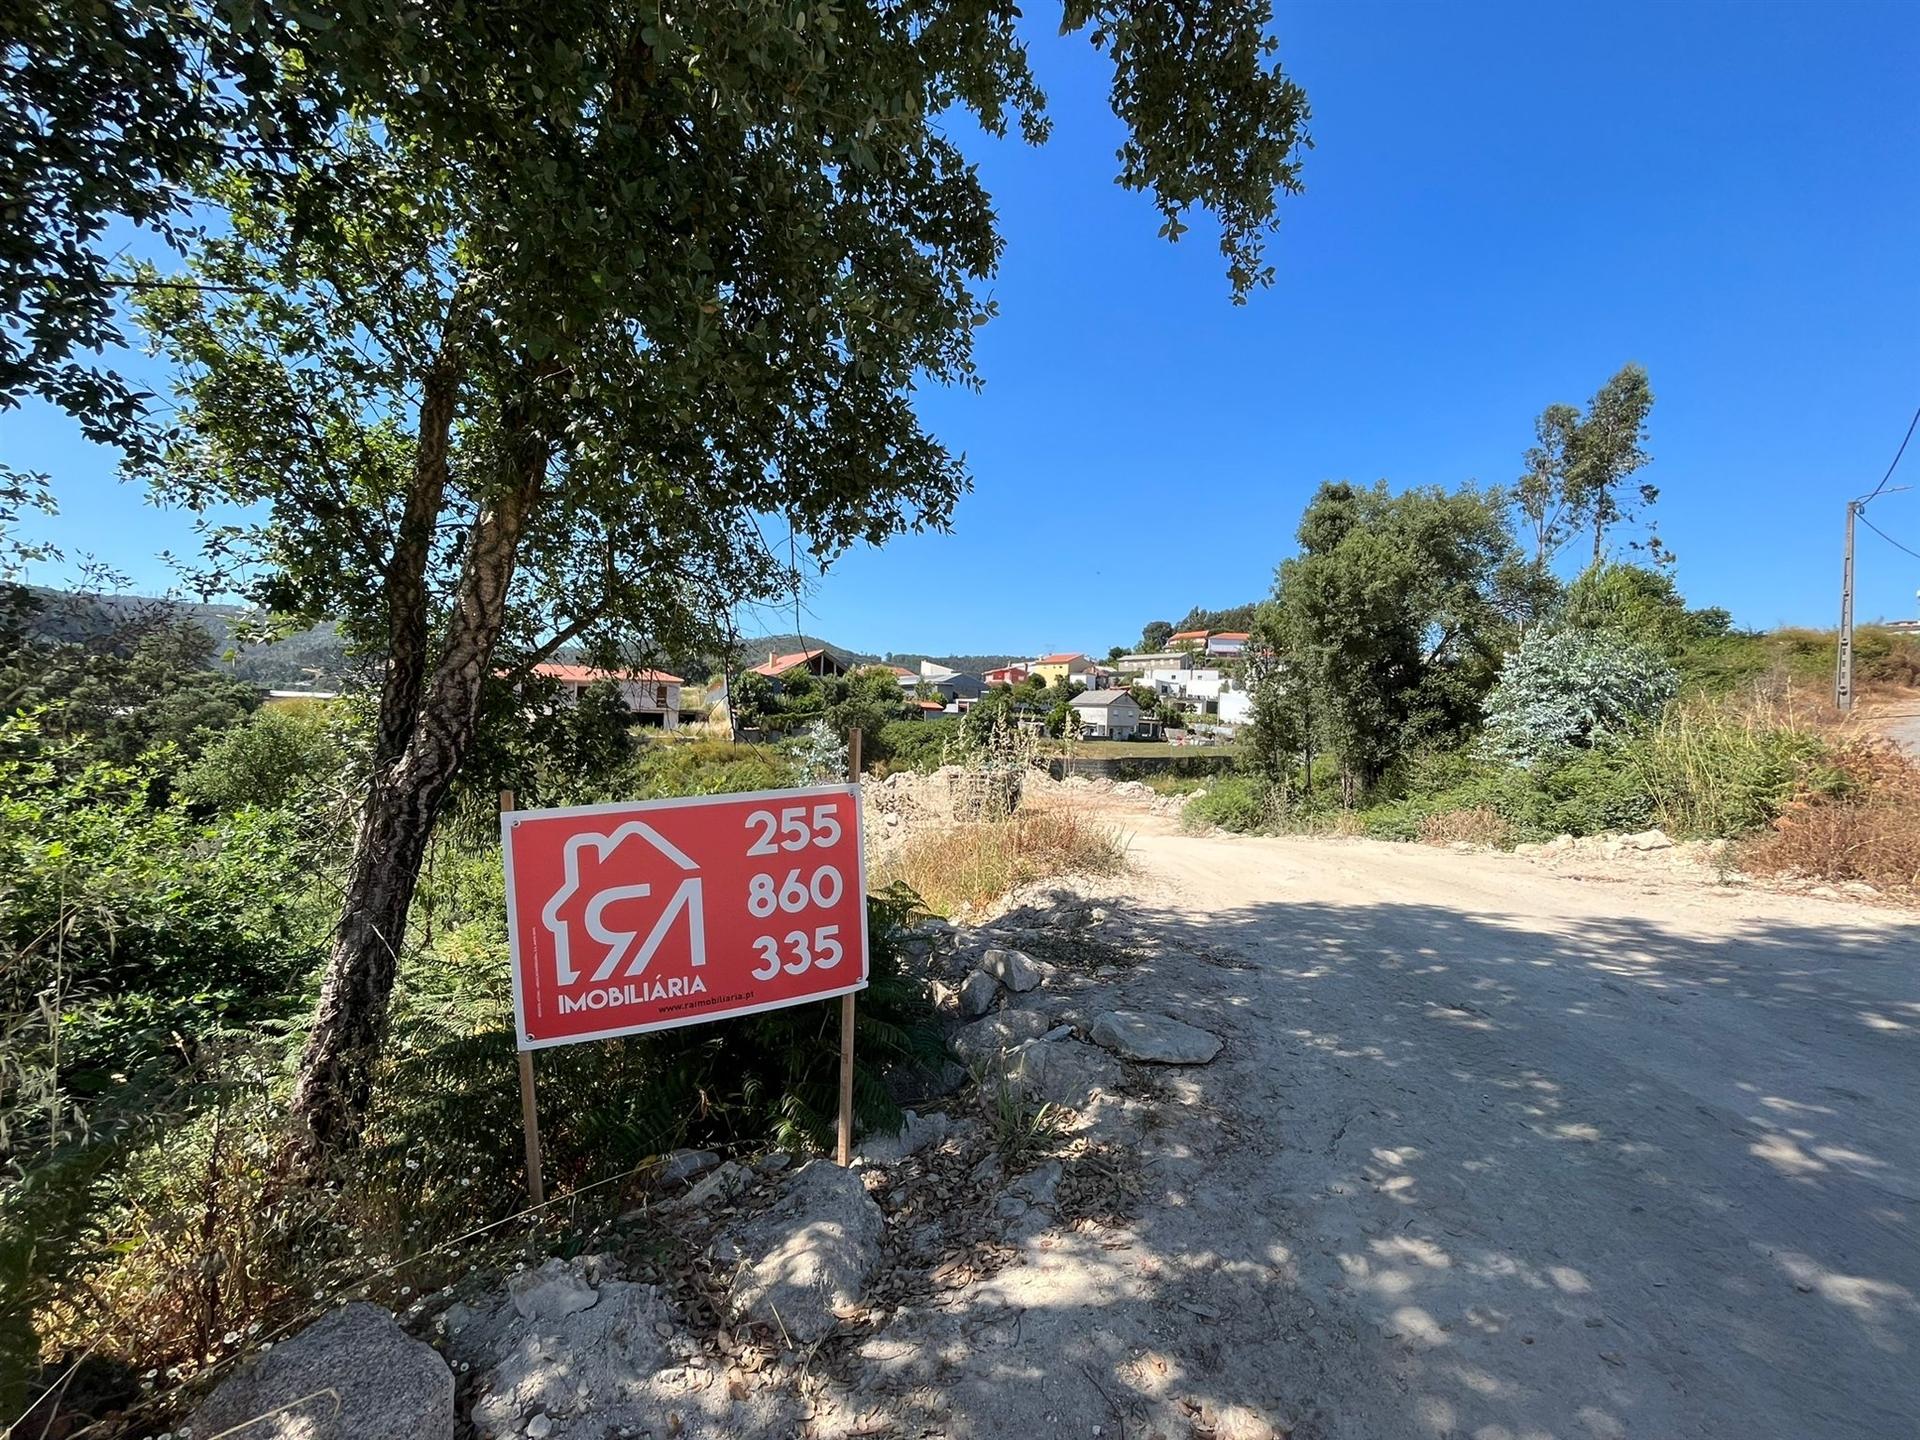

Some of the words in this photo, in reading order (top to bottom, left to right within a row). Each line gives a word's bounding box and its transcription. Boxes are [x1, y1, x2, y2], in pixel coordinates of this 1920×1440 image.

[744, 803, 842, 856] 255
[747, 865, 843, 918] 860
[751, 924, 843, 981] 335
[558, 974, 708, 1015] IMOBILIÁRIA
[658, 991, 755, 1013] www.raimobiliaria.pt
